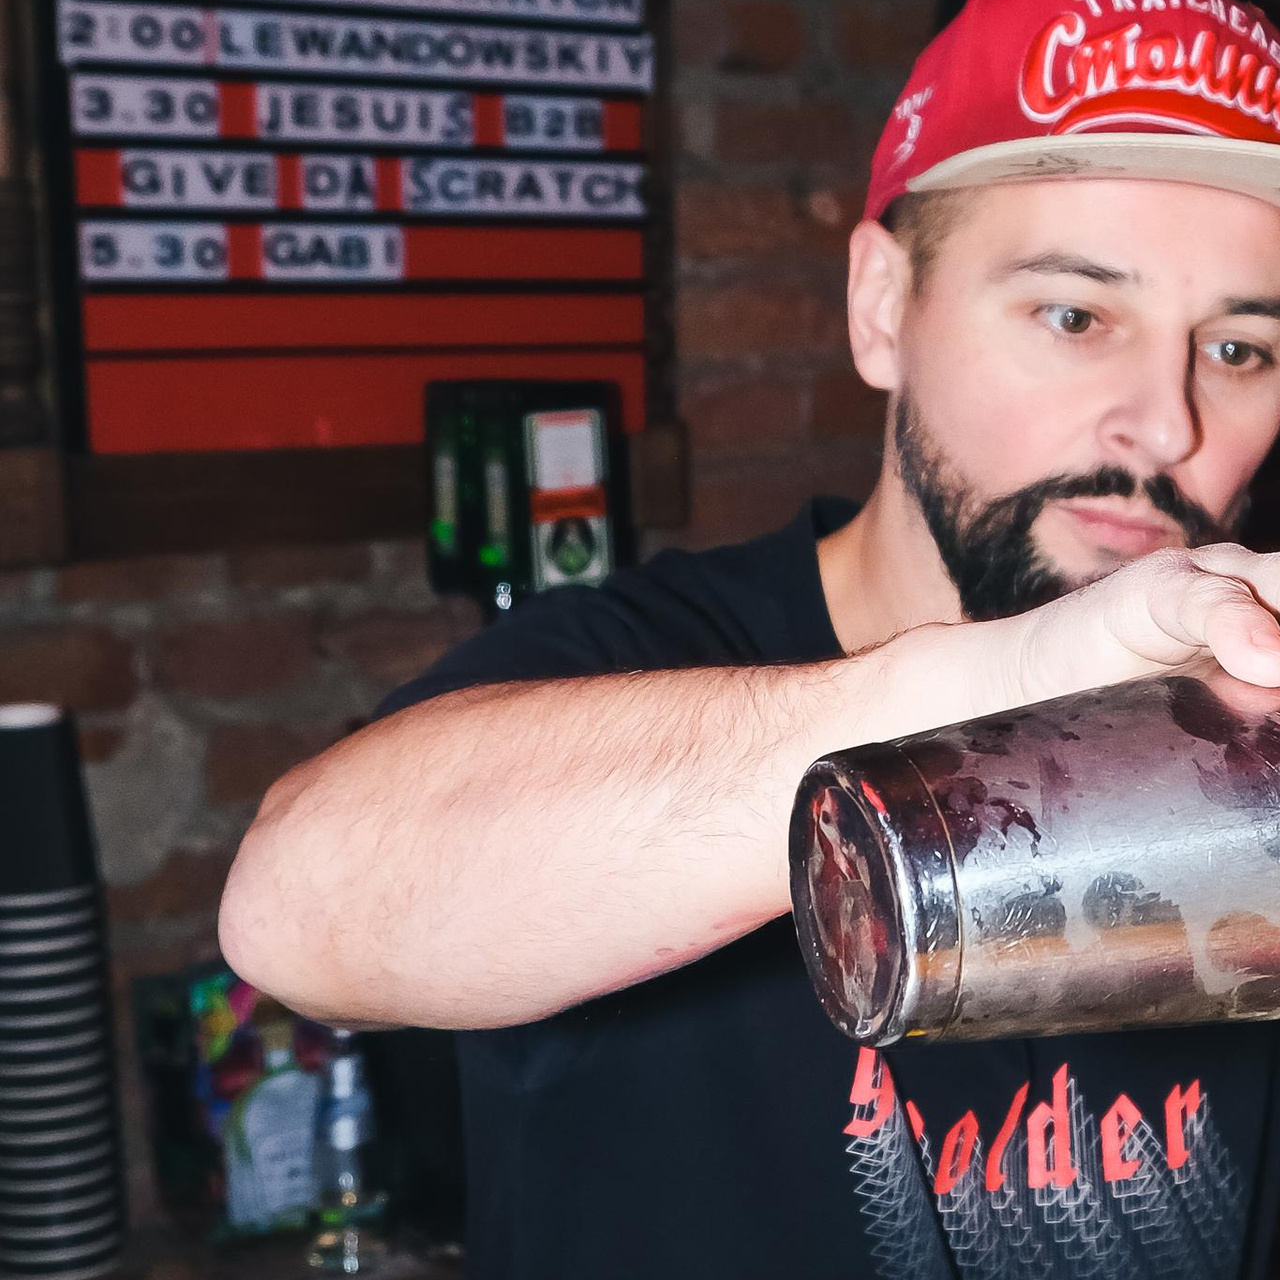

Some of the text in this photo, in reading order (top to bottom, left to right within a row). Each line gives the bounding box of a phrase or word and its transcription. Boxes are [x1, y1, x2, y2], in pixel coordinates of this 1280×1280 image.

[123, 158, 277, 198] GIVE
[305, 157, 372, 198] DA
[264, 232, 397, 270] GABI
